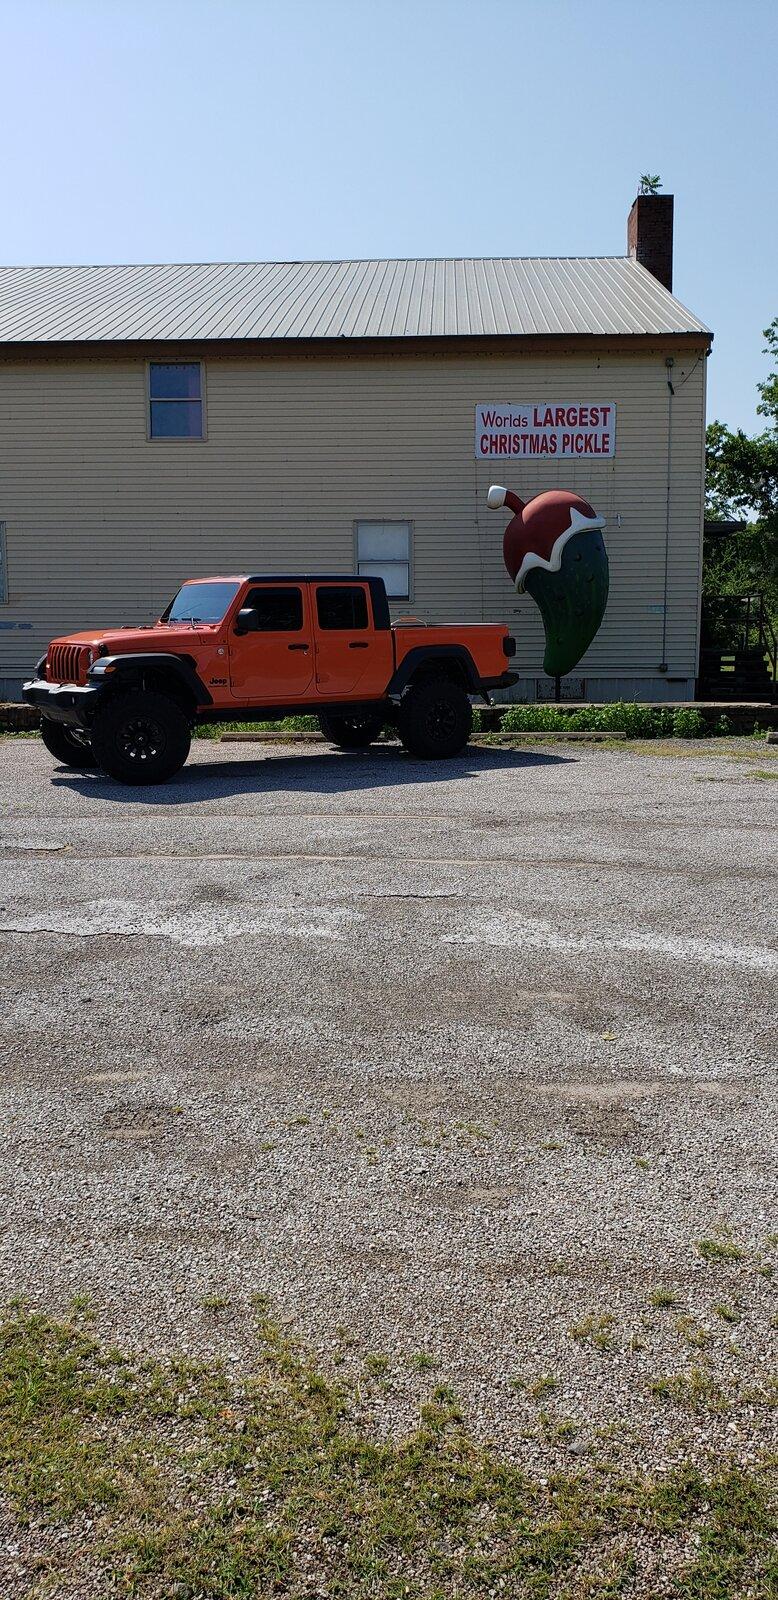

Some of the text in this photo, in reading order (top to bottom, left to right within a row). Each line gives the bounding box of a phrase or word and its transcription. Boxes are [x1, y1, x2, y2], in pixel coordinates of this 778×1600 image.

[481, 407, 611, 428] Worlds LARGEST
[480, 433, 610, 455] CHRISTMAS PICKLE
[209, 677, 227, 685] Jeep
